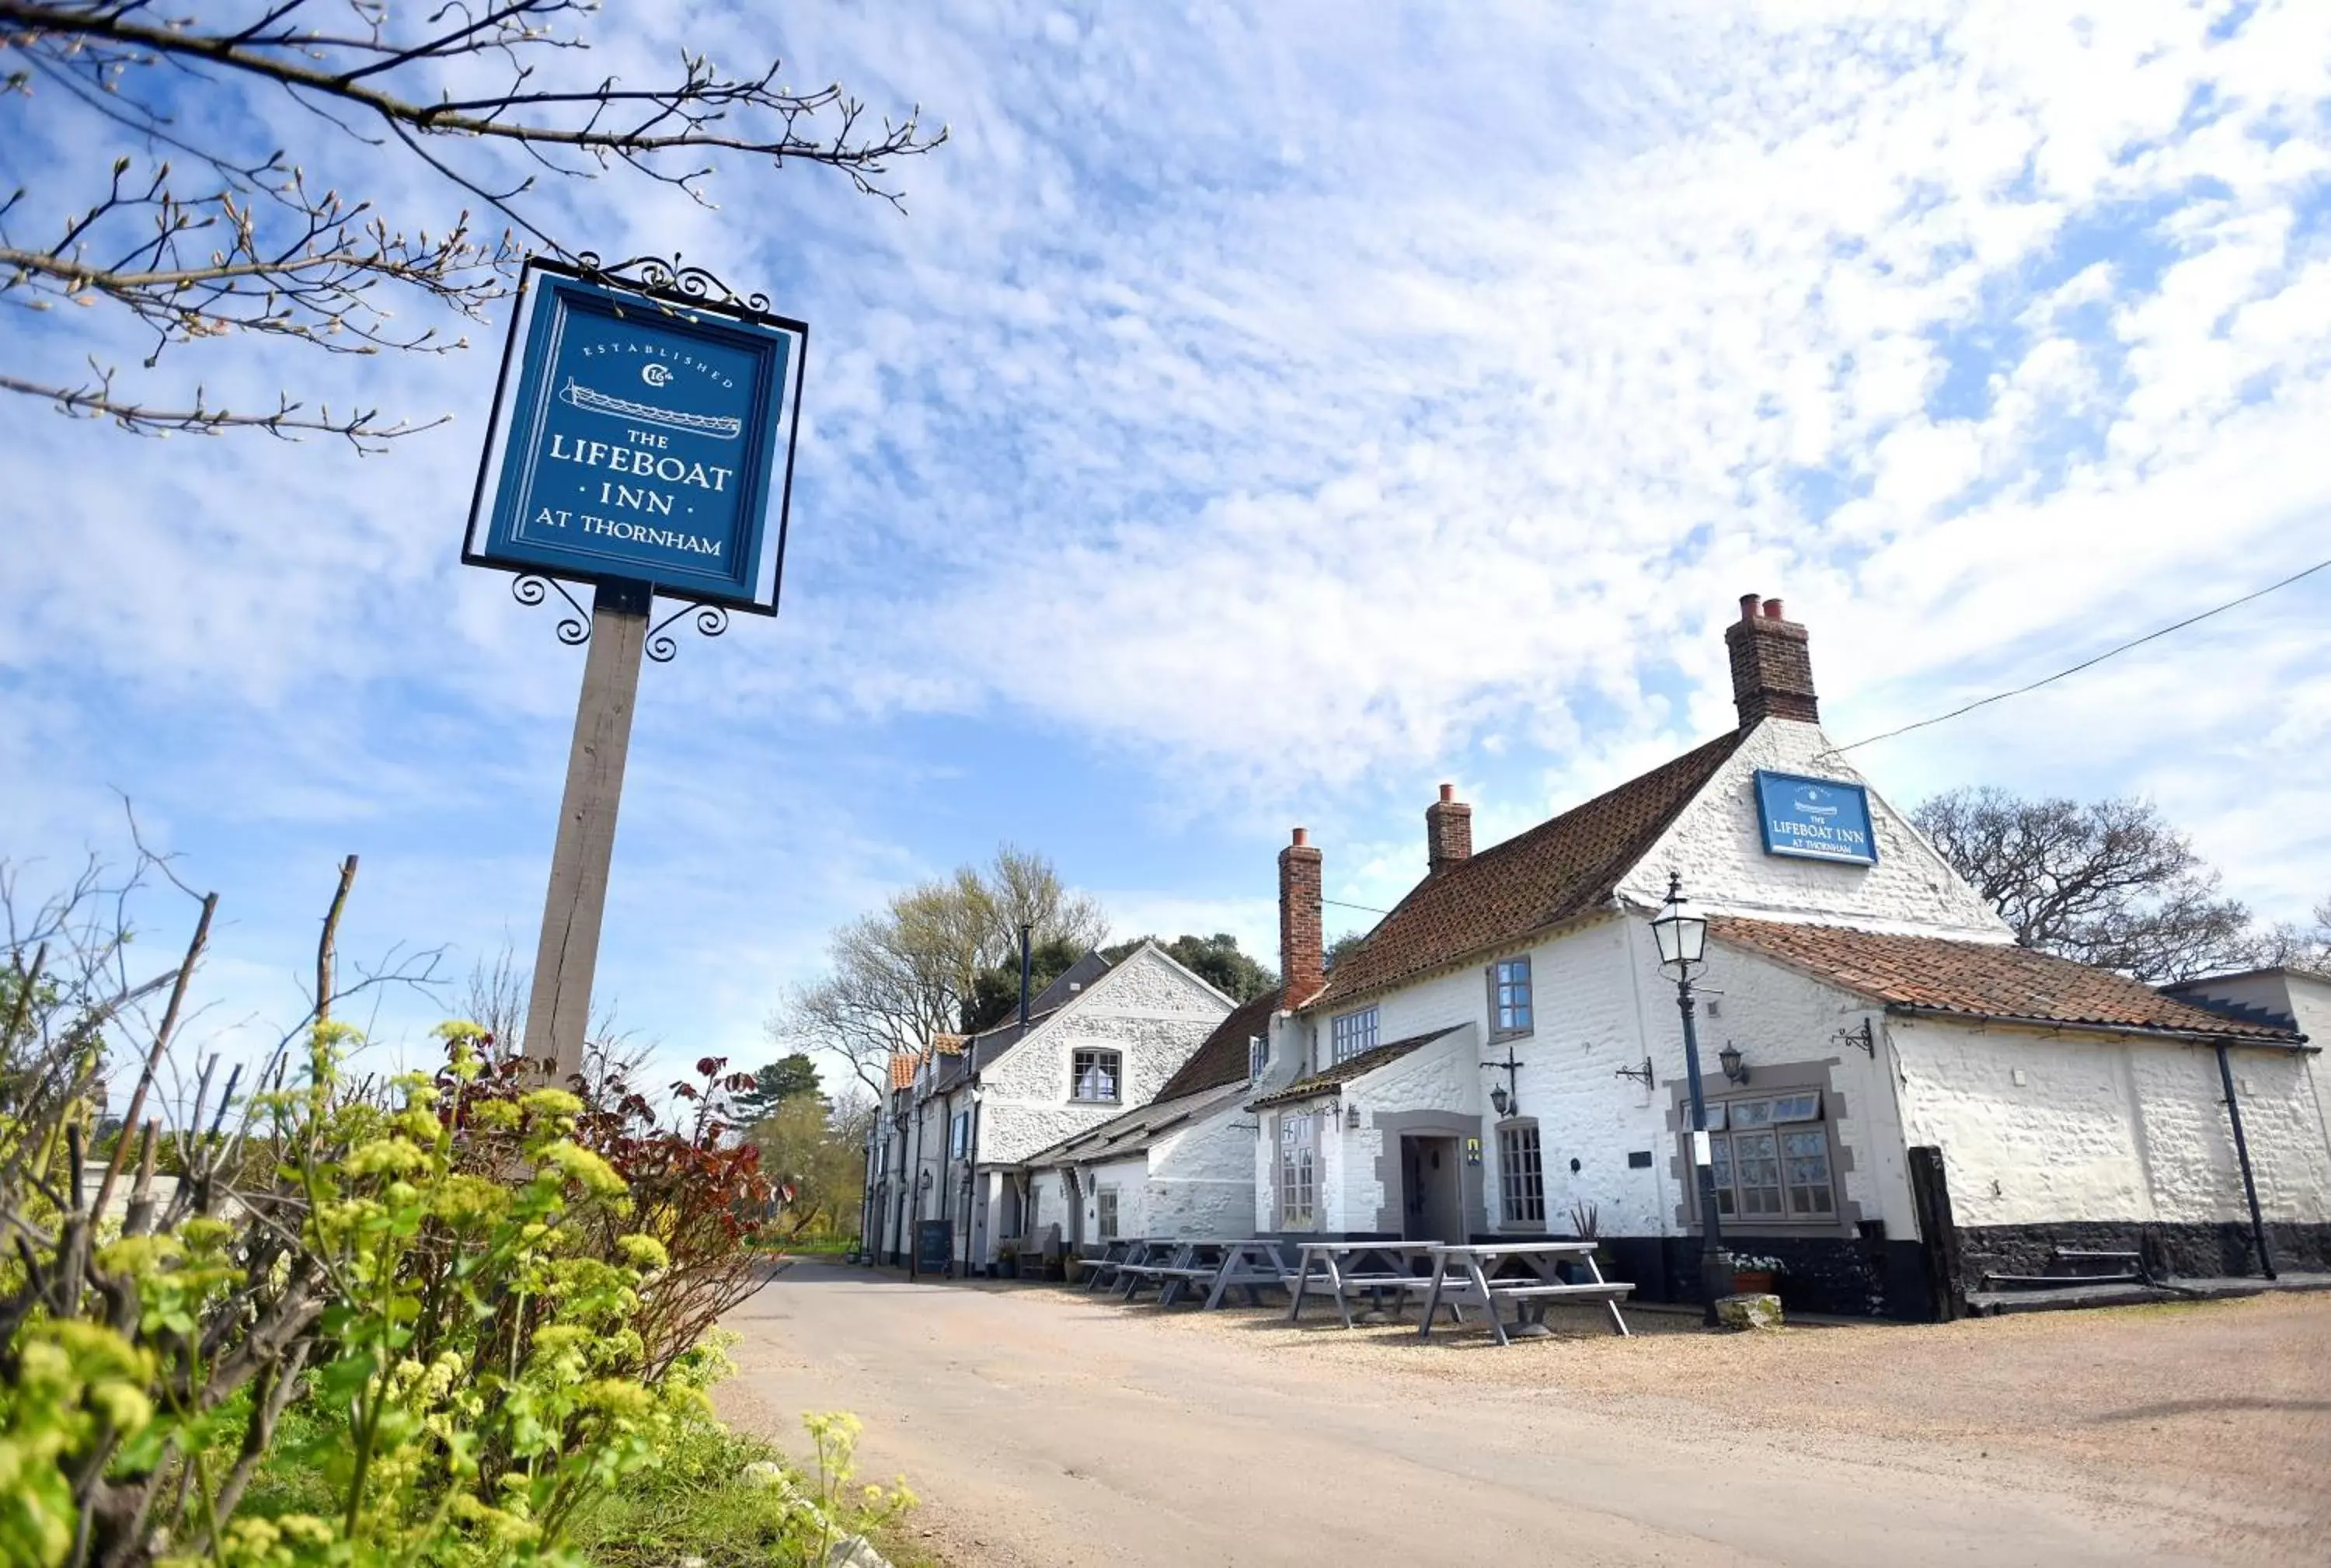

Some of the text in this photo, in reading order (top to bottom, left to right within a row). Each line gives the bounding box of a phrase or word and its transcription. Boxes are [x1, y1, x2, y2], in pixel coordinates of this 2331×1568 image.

[584, 343, 733, 388] ESTABLISHED
[627, 429, 669, 449] THE
[549, 434, 733, 491] LIFEBOAT
[600, 482, 674, 516] INN
[535, 507, 721, 556] AT THORNHAM
[1773, 821, 1864, 844] LIFEBOAT INN
